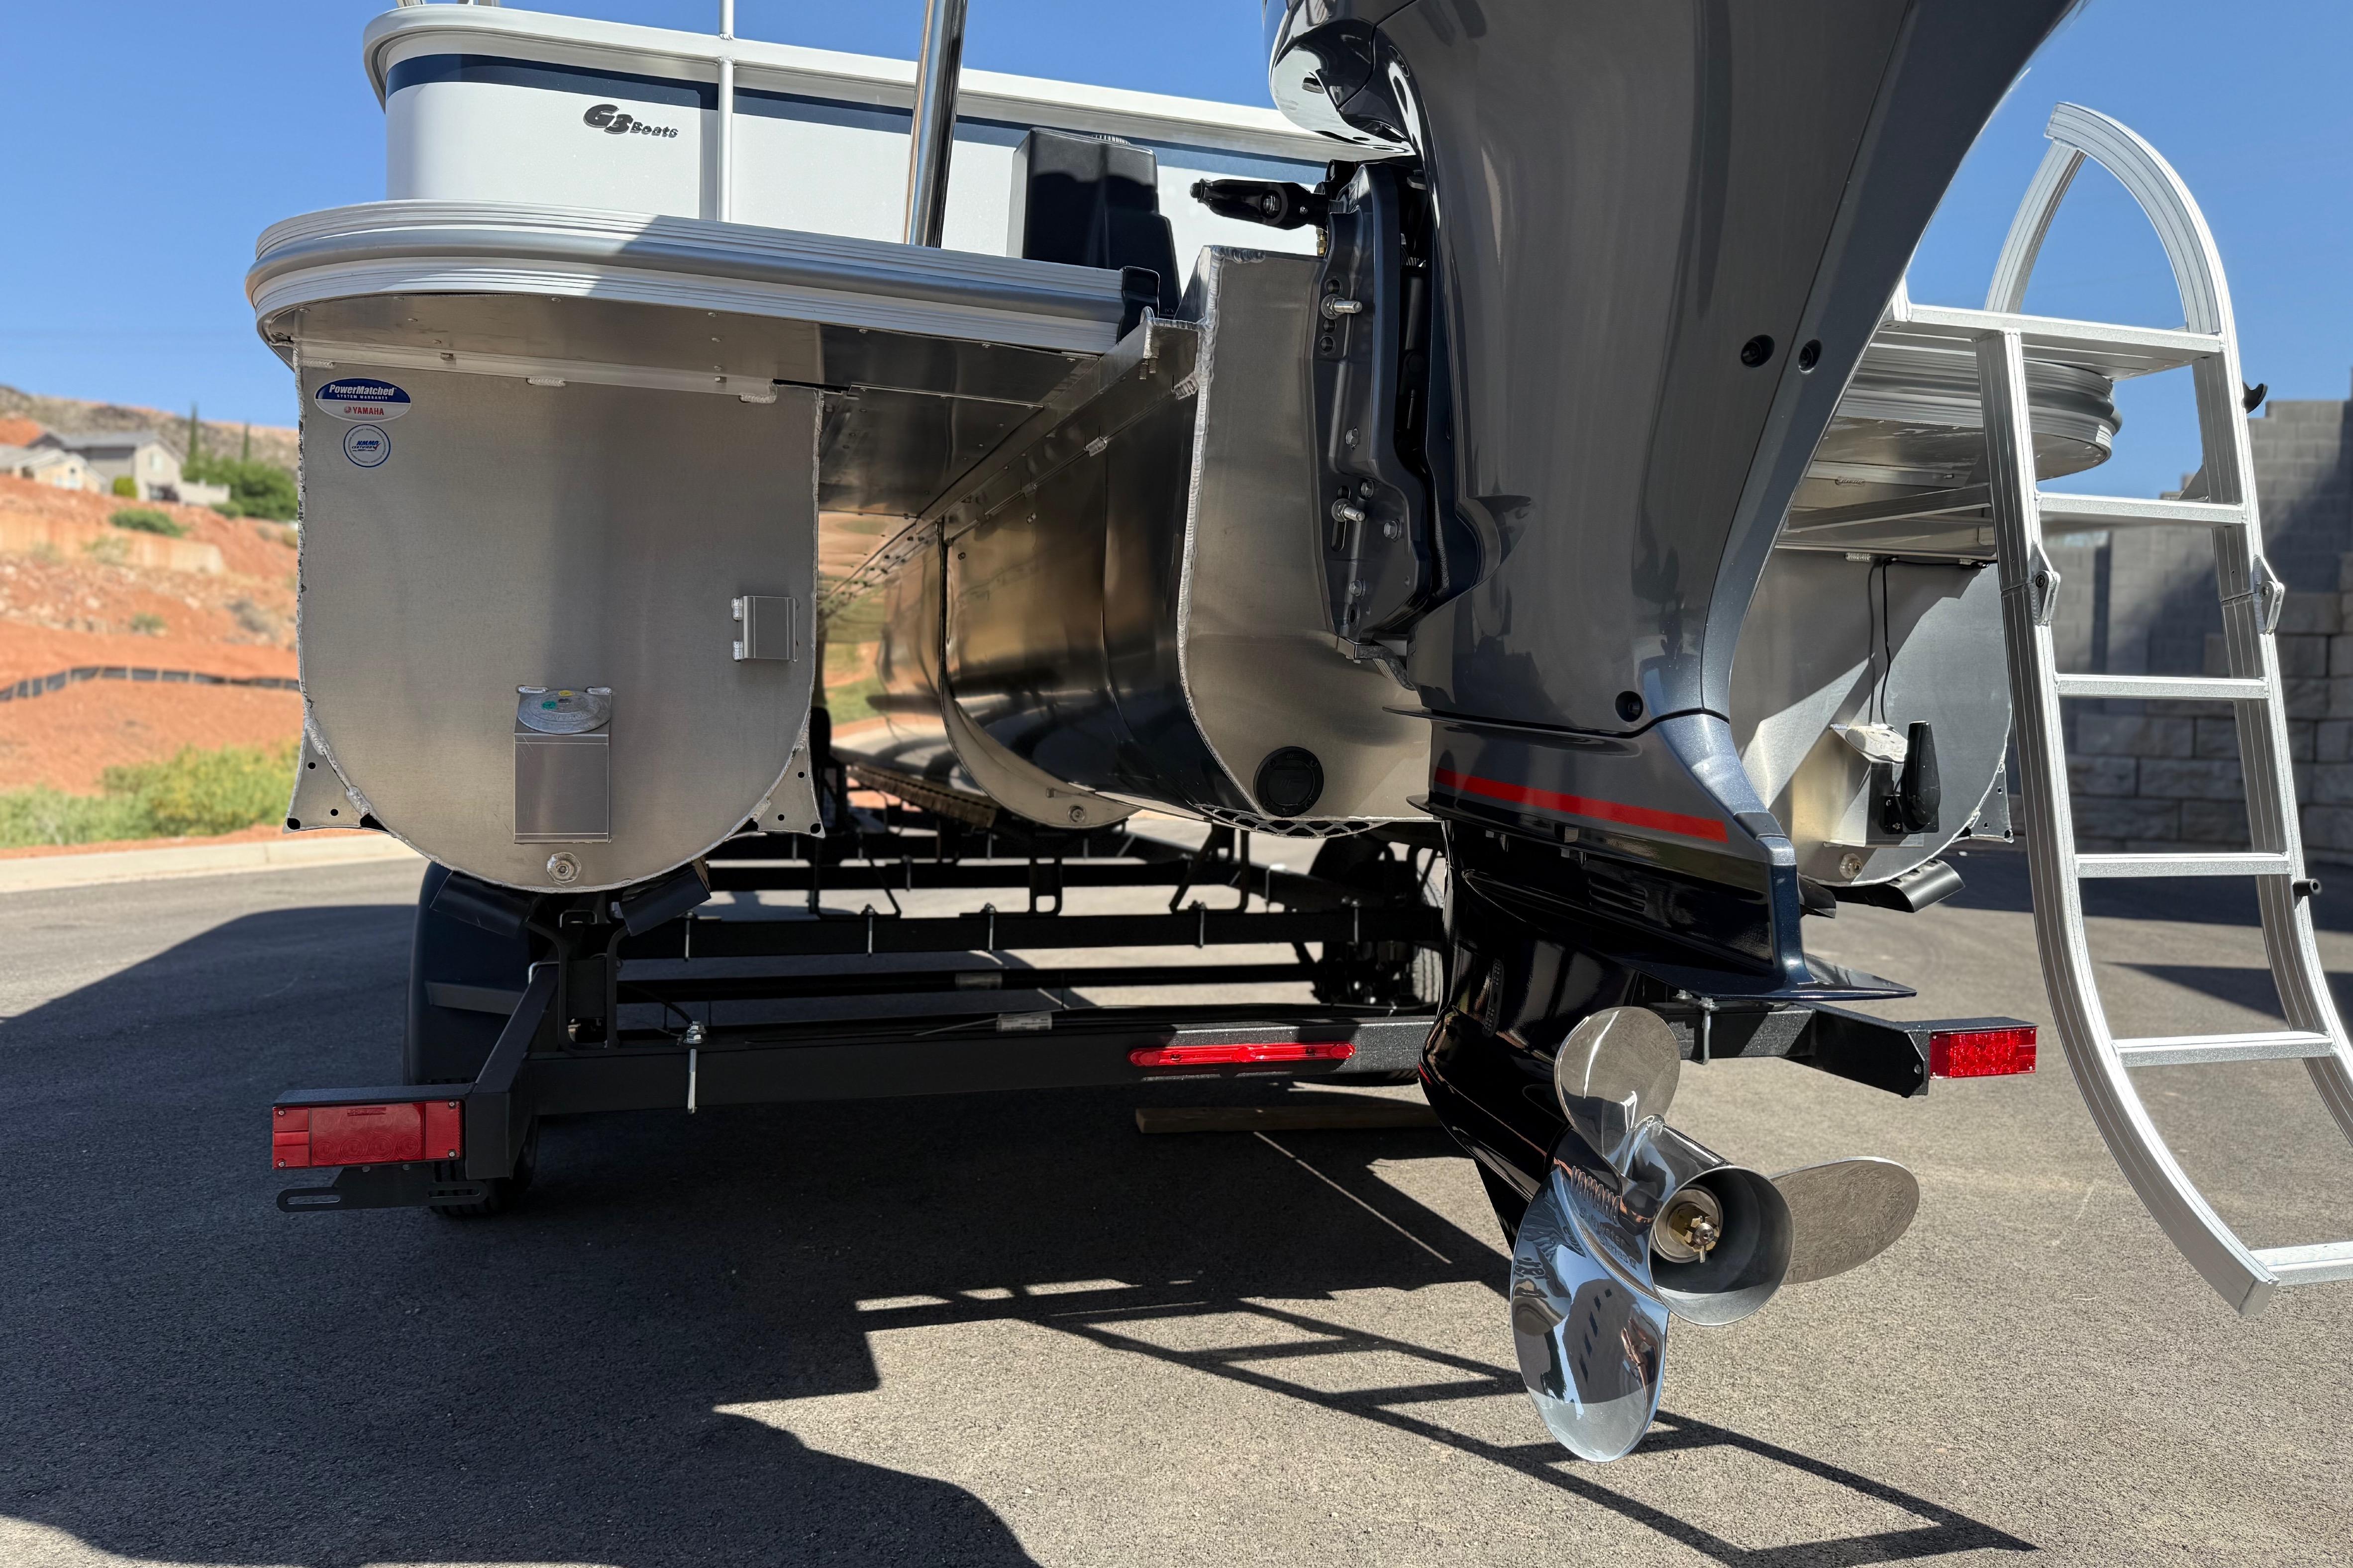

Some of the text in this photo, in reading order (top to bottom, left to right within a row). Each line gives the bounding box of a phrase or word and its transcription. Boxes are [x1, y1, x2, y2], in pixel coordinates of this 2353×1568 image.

[583, 103, 679, 138] G3 Boats
[329, 385, 395, 396] PowerMatched
[353, 407, 384, 415] YAMAHA
[1570, 1165, 1621, 1225] YAMAHA
